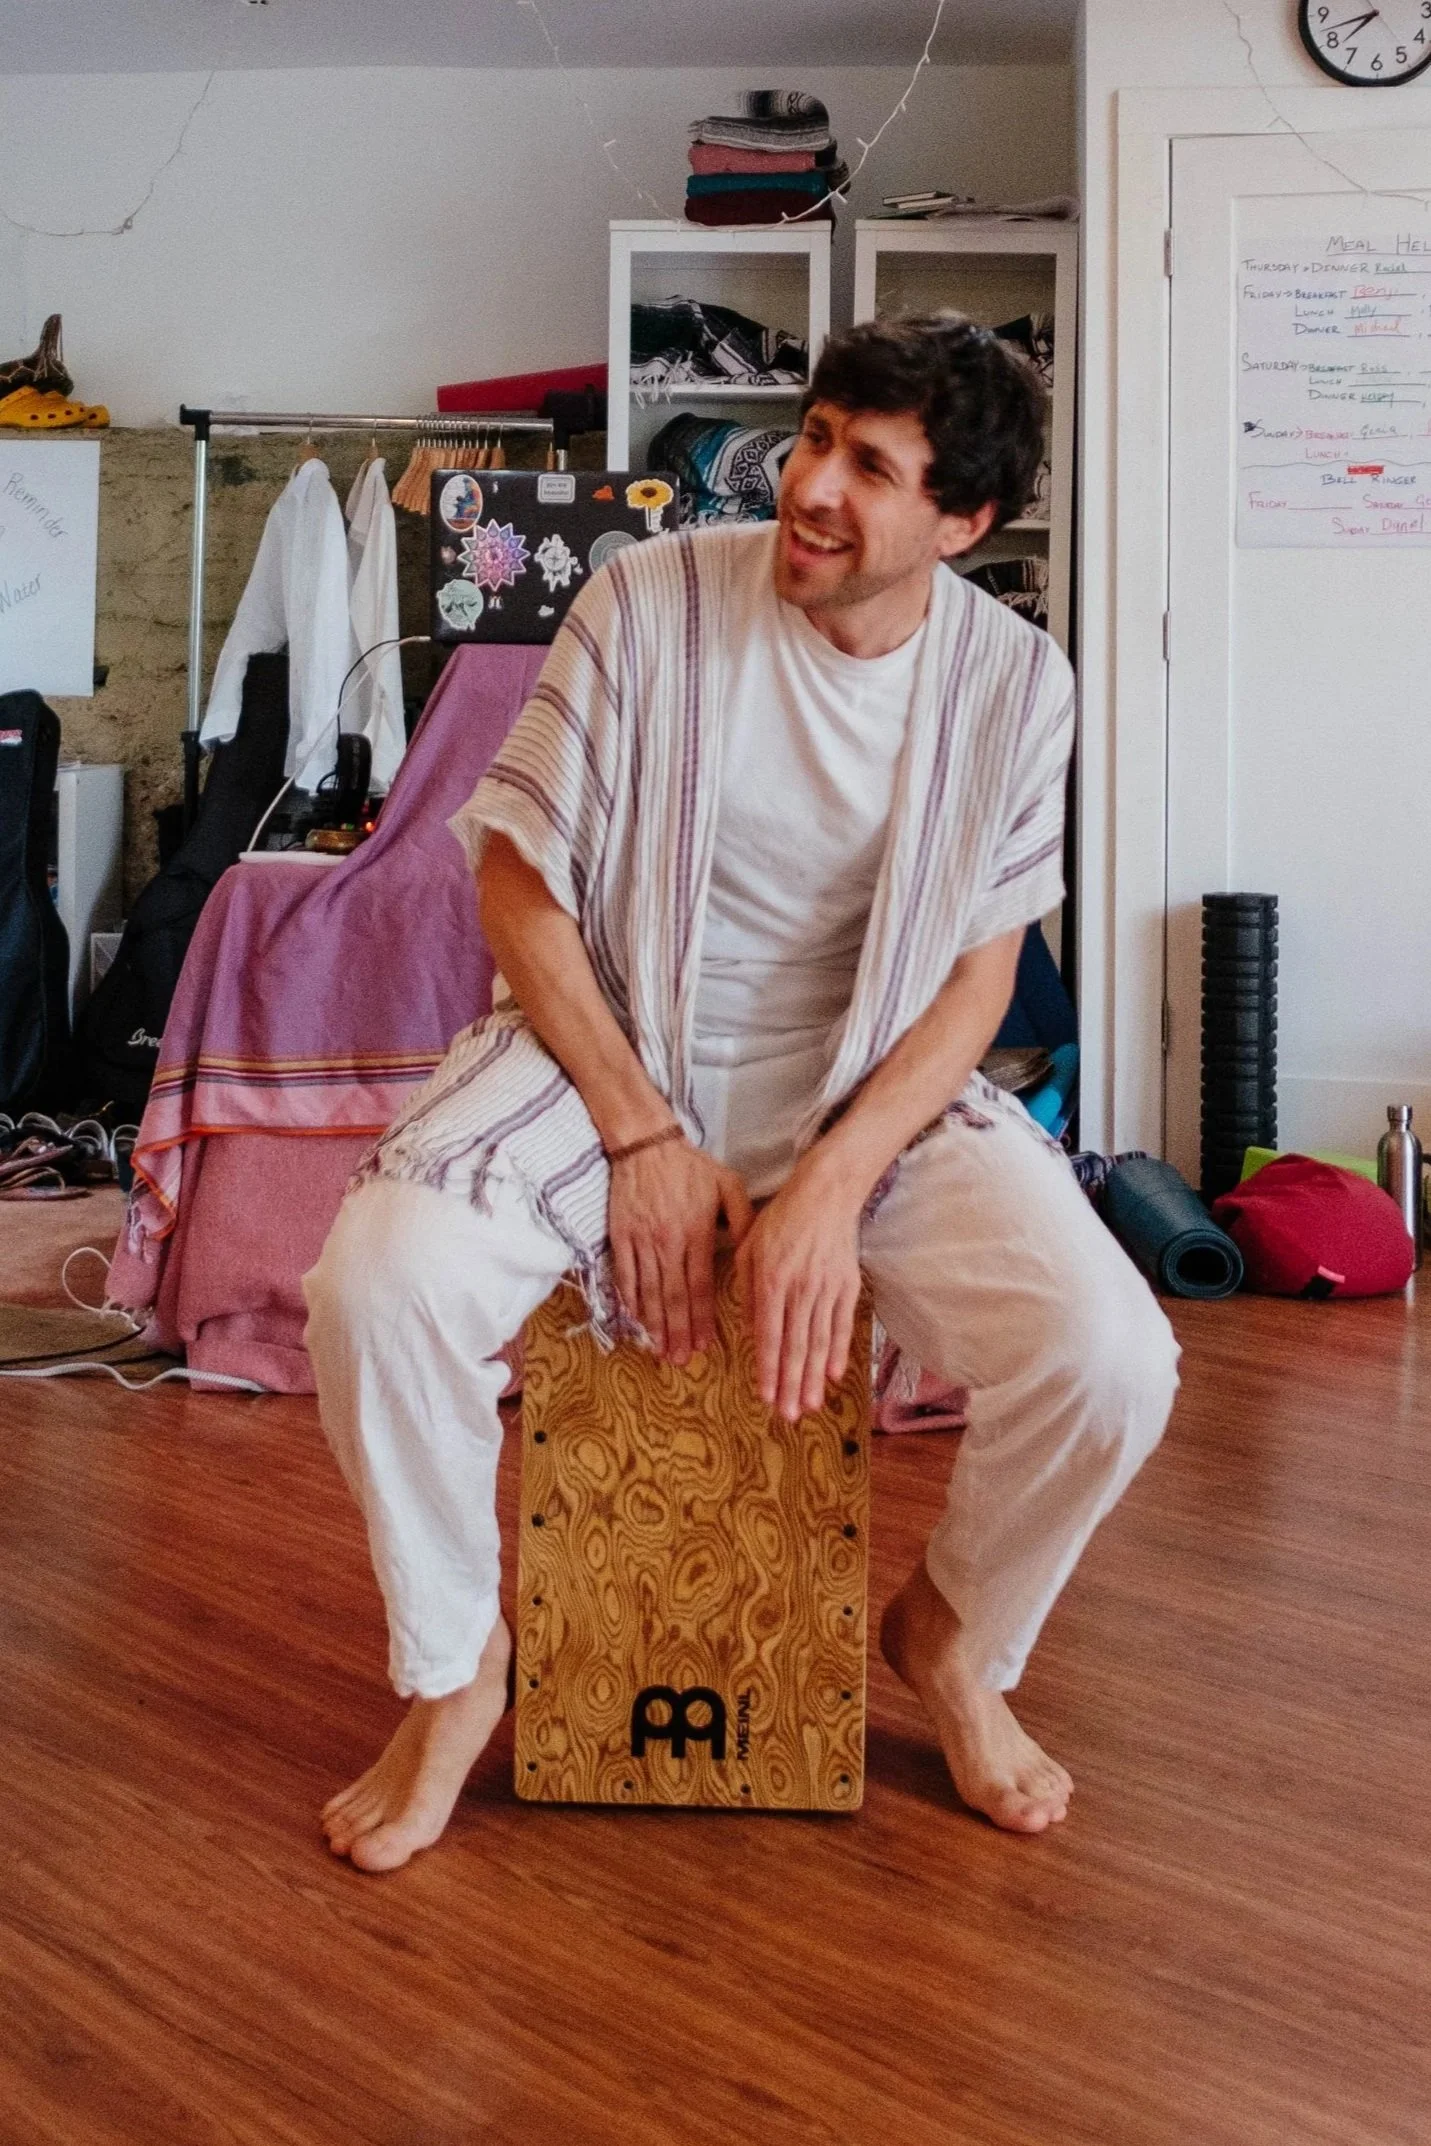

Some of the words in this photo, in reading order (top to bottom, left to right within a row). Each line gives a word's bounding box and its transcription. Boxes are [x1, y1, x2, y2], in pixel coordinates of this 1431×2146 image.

[1318, 6, 1329, 23] 9
[1421, 1, 1431, 19] 3
[1327, 31, 1339, 49] 8
[1413, 28, 1426, 44] 4
[1345, 47, 1358, 65] 7
[1371, 53, 1383, 71] 6
[1396, 46, 1408, 64] 5
[1326, 235, 1376, 252] MEAL
[1241, 258, 1299, 273] THURSDAY
[1312, 262, 1370, 273] DINNER
[1243, 285, 1281, 299] FRIDAY
[1295, 304, 1334, 317] LUNCH
[1242, 352, 1300, 371] SATURDAY
[1308, 389, 1356, 400] DINNER
[1321, 474, 1357, 485] BELL
[1371, 474, 1416, 485] RINGER
[1249, 491, 1288, 508] FRIDAY
